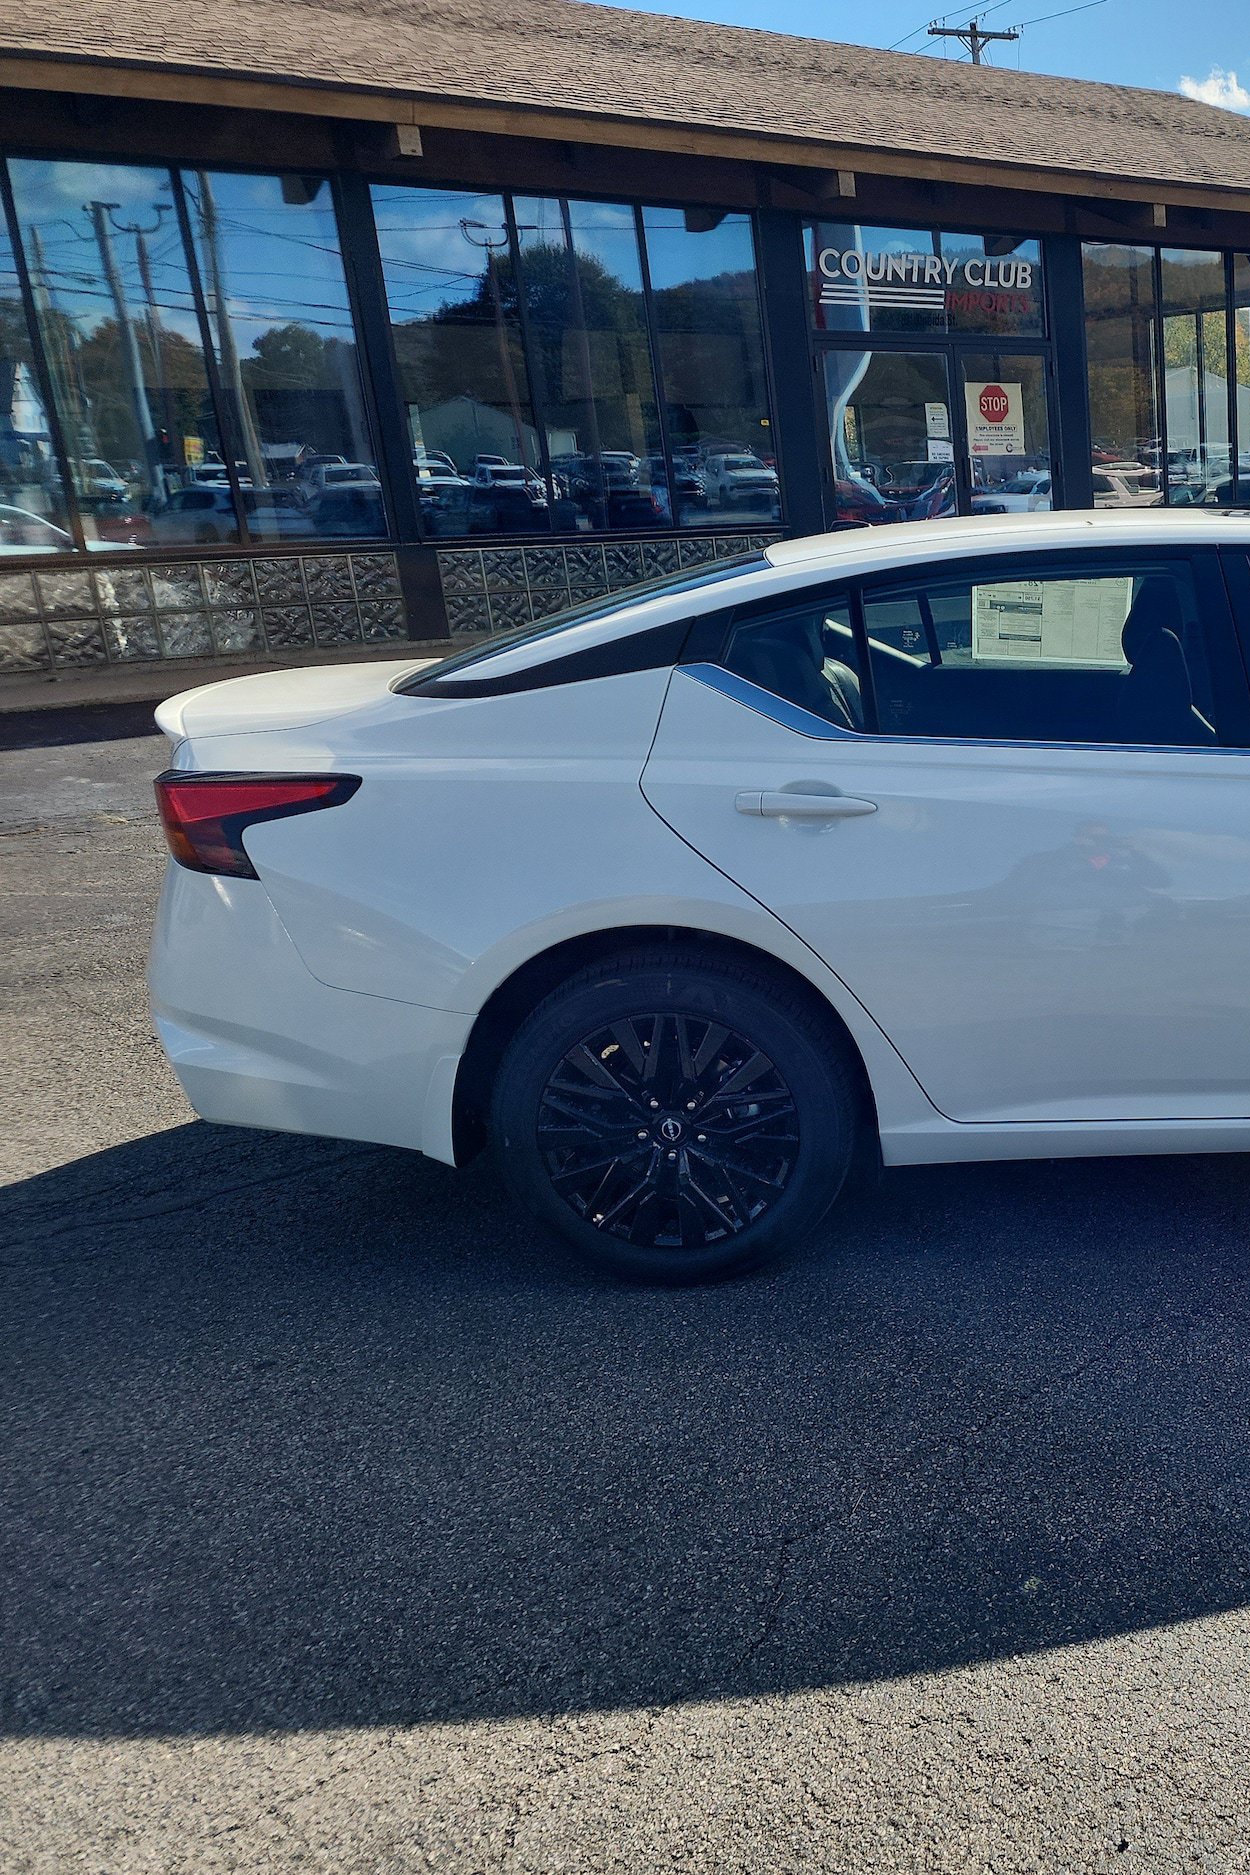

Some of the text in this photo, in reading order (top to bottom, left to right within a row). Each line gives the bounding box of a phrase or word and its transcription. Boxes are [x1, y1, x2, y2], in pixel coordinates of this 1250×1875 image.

[818, 247, 1033, 289] COUNTRY CLUB
[945, 290, 1030, 314] IMPORTS
[980, 396, 1007, 411] STOP
